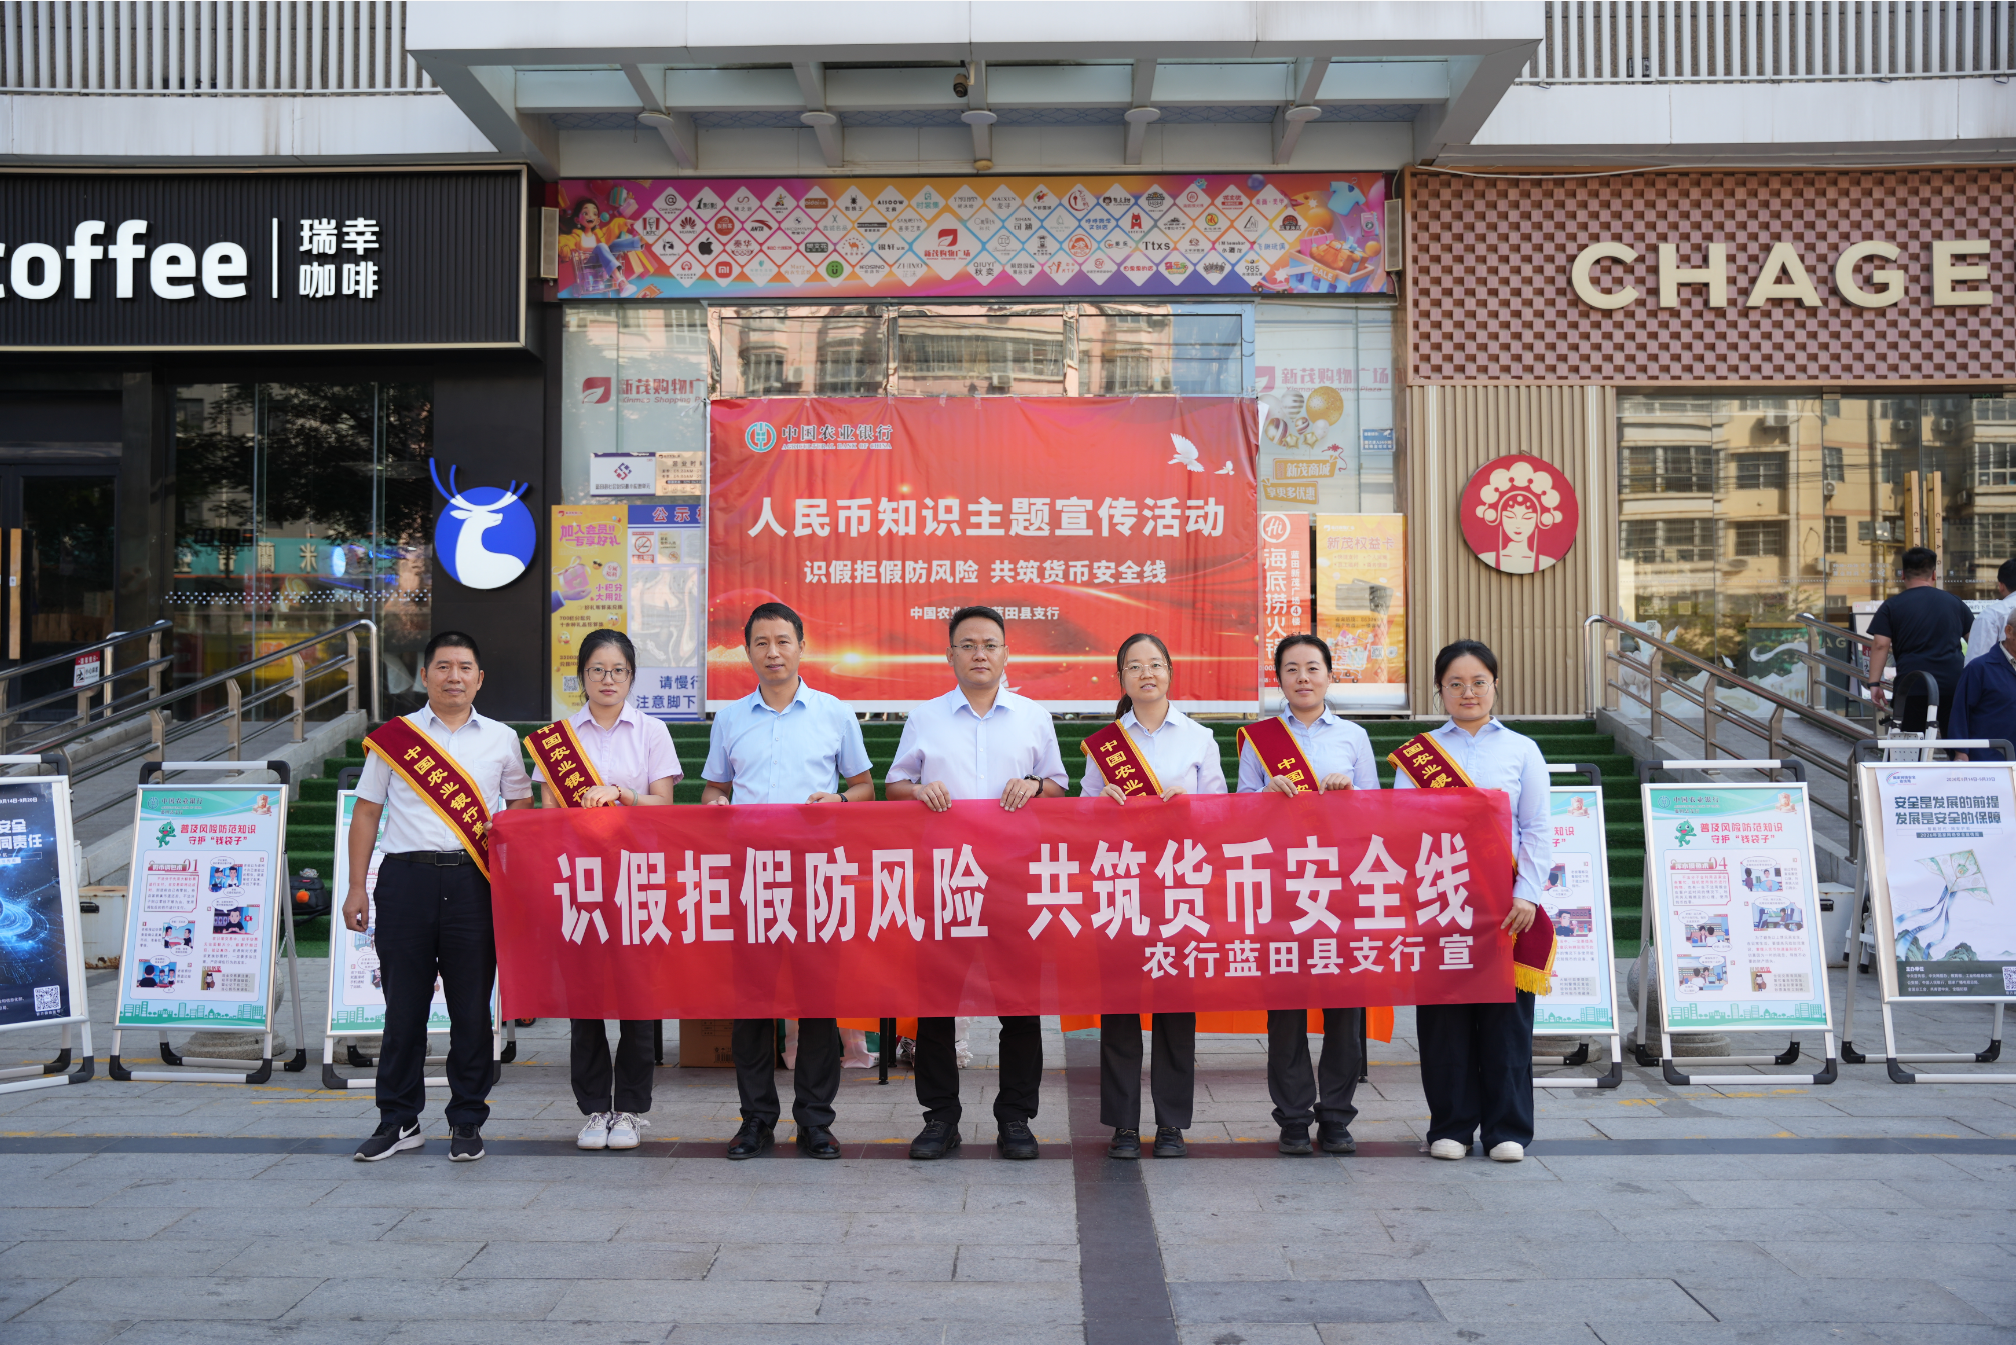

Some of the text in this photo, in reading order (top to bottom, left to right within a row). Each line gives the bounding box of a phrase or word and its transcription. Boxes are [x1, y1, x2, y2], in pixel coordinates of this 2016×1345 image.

[299, 217, 381, 256] 瑞幸
[1142, 241, 1170, 250] Ttxs
[0, 219, 248, 300] offee
[299, 261, 380, 299] 咖啡
[1313, 266, 1334, 281] SALE
[1571, 240, 1994, 310] CHAGE
[1281, 367, 1389, 384] 新茂购物广场
[782, 424, 893, 442] 中国农业银行
[781, 442, 836, 450] AGRICULTURAL
[1286, 462, 1331, 477] 新茂商城
[1266, 486, 1316, 500] 享更多优惠
[747, 496, 1225, 538] 人民币知识主题宣传活动
[1327, 536, 1395, 550] 新茂权益卡
[804, 559, 1167, 585] 识假拒假防风险 共筑货币安全线
[595, 583, 623, 592] 小积分
[595, 593, 623, 601] 大用处
[910, 606, 1060, 620] 中国农蓝田县支行
[636, 694, 697, 709] 注意脚下
[1100, 740, 1147, 796] 中国农业
[1399, 739, 1453, 788] 国农业银
[161, 797, 203, 805] 中国农业银行
[1673, 796, 1720, 804] 中国农业银行
[1894, 796, 2000, 809] 安全是发展的前提
[1895, 811, 2002, 825] 发展是安全的保障
[181, 824, 256, 834] 普及风险防范知识
[1554, 826, 1575, 836] 知识
[1700, 822, 1783, 833] 普及风险防范知识
[189, 835, 206, 845] 守护
[1711, 834, 1730, 844] 守护
[553, 832, 1474, 946] 识假拒假防风险 共筑货币安全线
